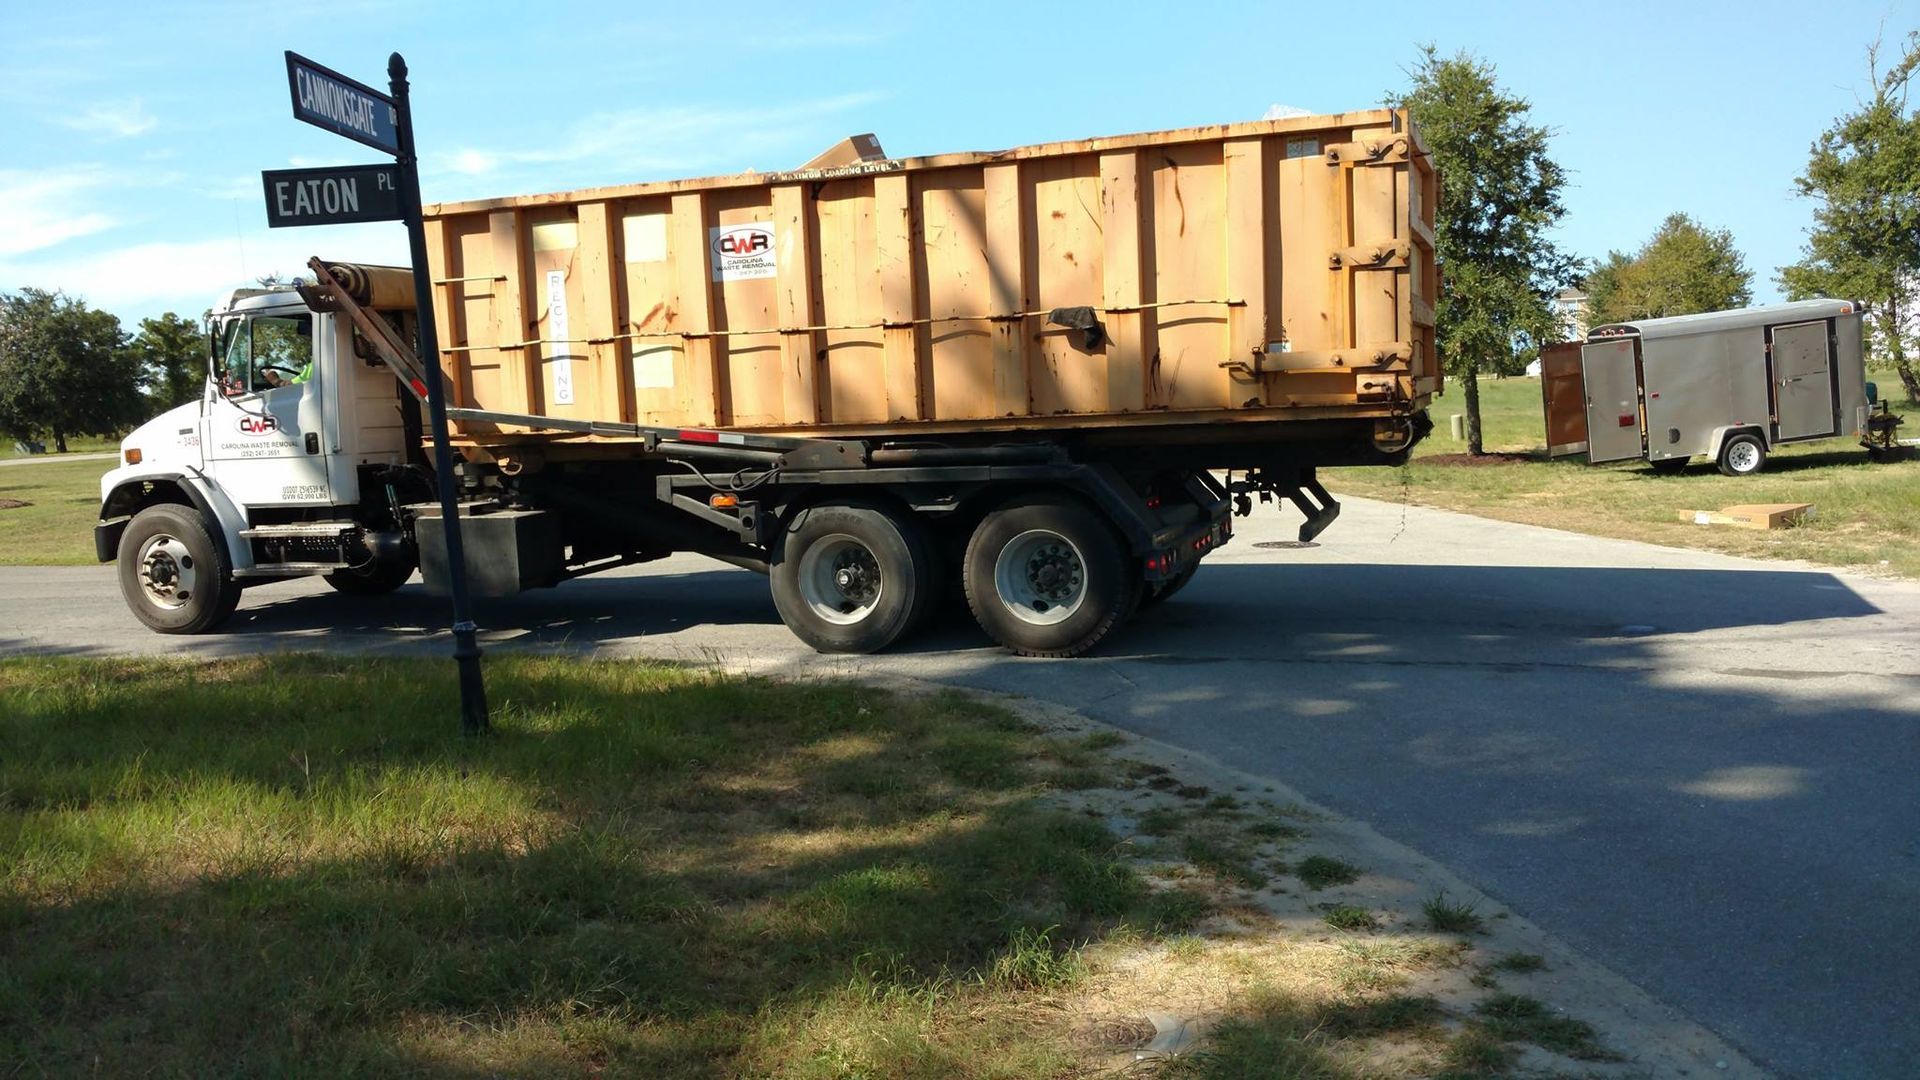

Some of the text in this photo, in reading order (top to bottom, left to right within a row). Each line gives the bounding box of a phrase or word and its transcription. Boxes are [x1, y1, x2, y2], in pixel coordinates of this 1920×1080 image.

[296, 67, 378, 137] CANNONSGATE
[781, 163, 892, 181] MAXIMUM LOADING LEVEL
[275, 173, 396, 217] EATON PL
[720, 232, 769, 254] CWR
[716, 264, 741, 272] WASTE
[742, 262, 777, 270] REMOVAL
[727, 257, 764, 266] CAROLINA
[240, 416, 276, 433] CWR
[220, 440, 299, 450] CAROLINA WASTE REMOVAL
